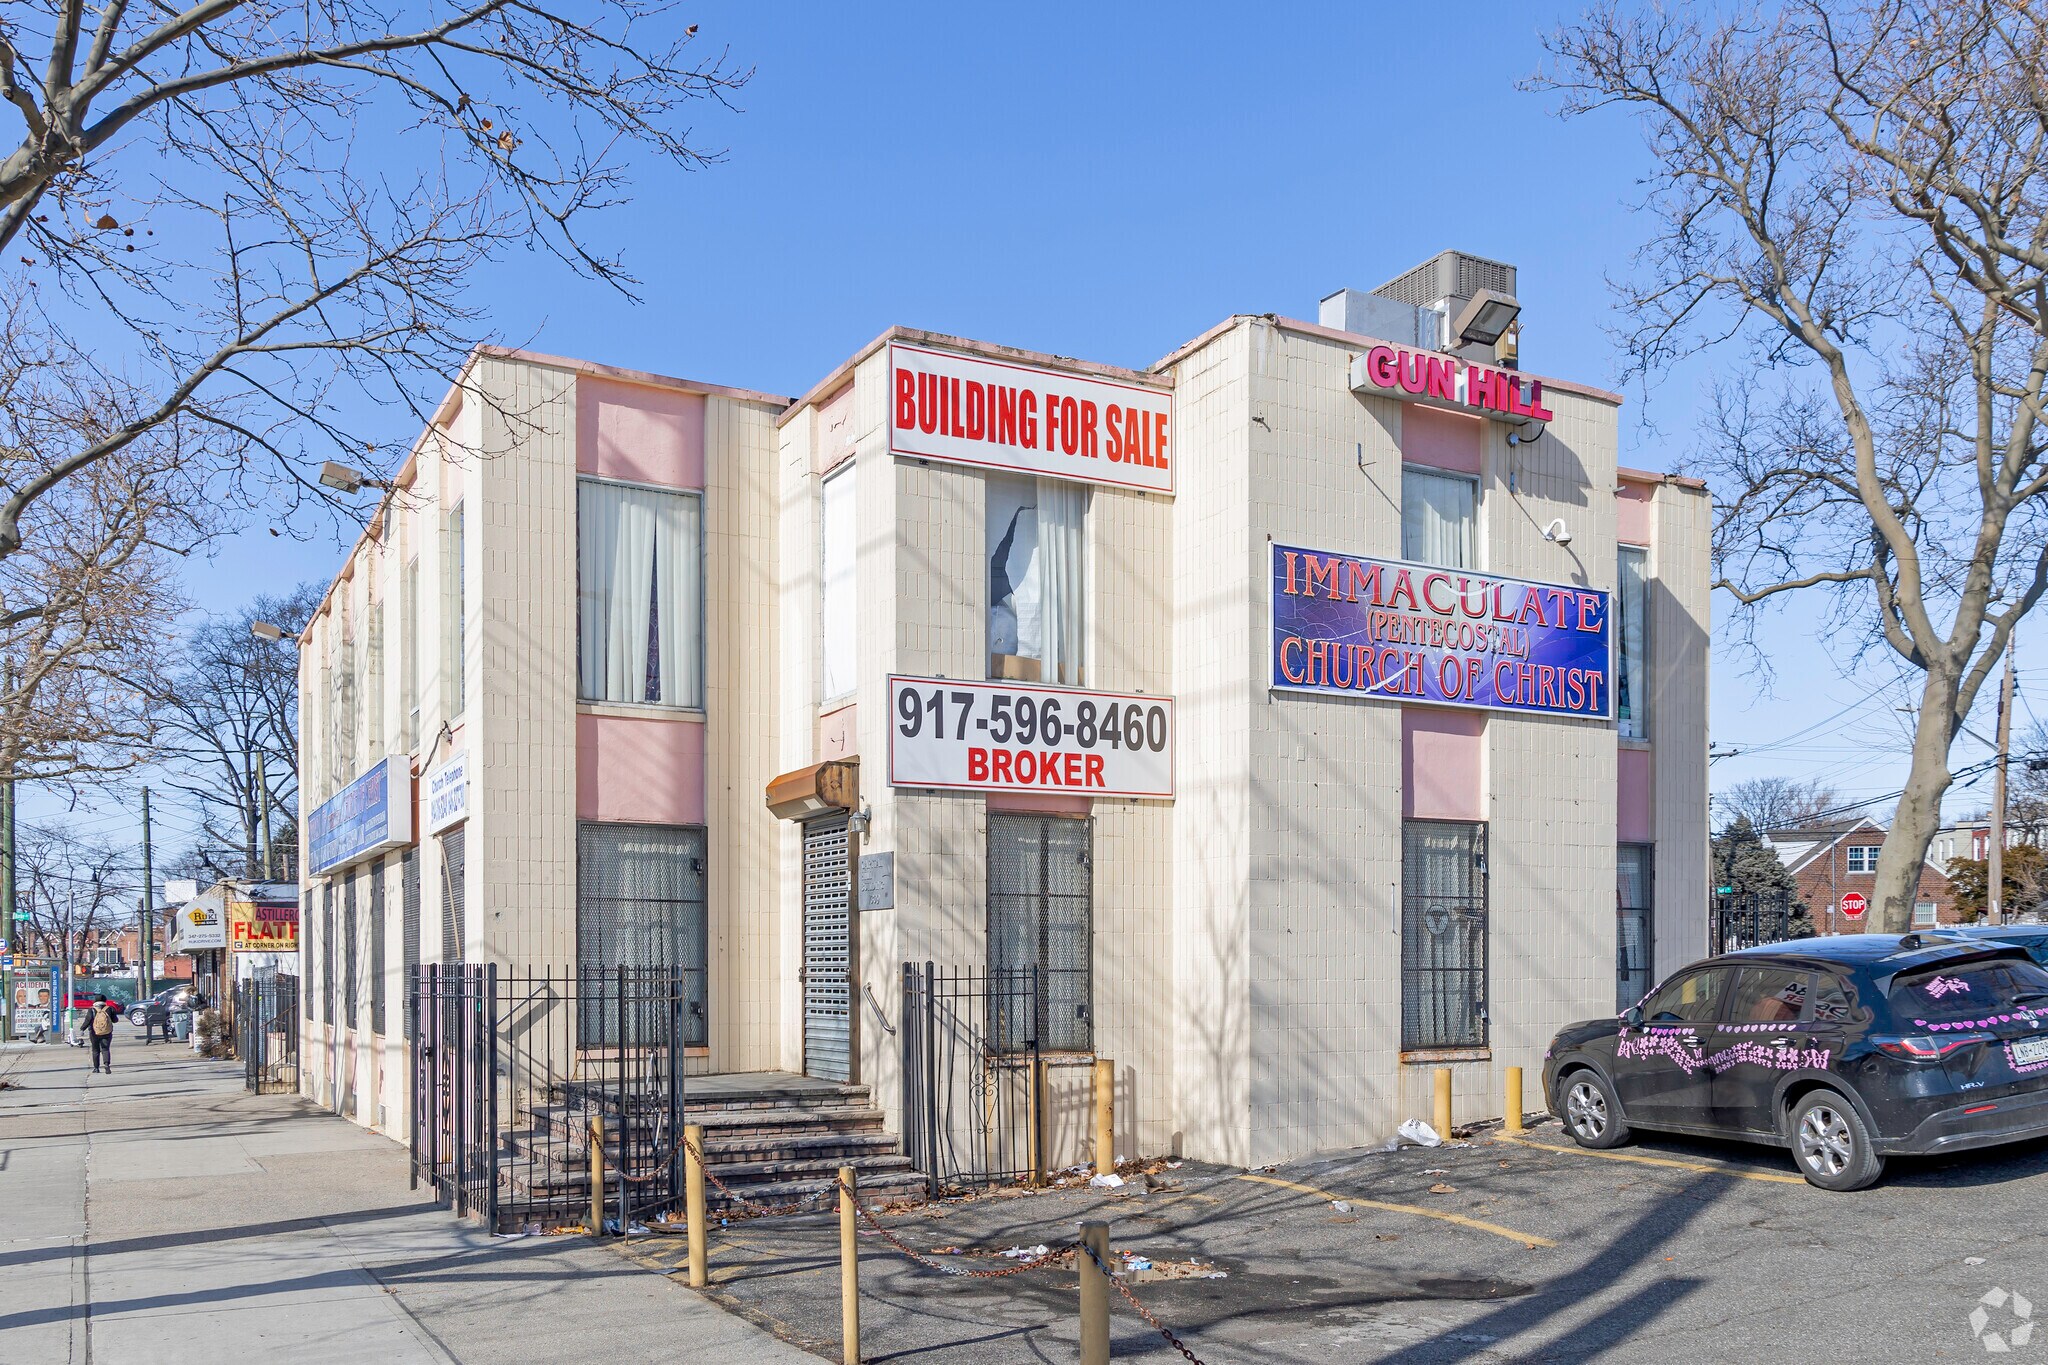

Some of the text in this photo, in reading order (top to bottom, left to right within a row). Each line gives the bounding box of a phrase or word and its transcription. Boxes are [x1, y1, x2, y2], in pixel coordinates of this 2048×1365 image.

[1367, 345, 1553, 422] GUN HILL
[896, 367, 1168, 470] BUILDING FOR SALE
[1283, 550, 1604, 634] IMMACULATE
[1366, 609, 1531, 660] (PENTECOSTAL)
[1280, 635, 1604, 712] CHURCH OF CHRIST
[898, 686, 1167, 753] 917-596-8460
[431, 775, 444, 794] Church
[967, 746, 1106, 789] BROKER
[1842, 899, 1865, 910] STOP
[234, 922, 287, 940] FLAT
[1960, 1081, 1985, 1090] HR-V
